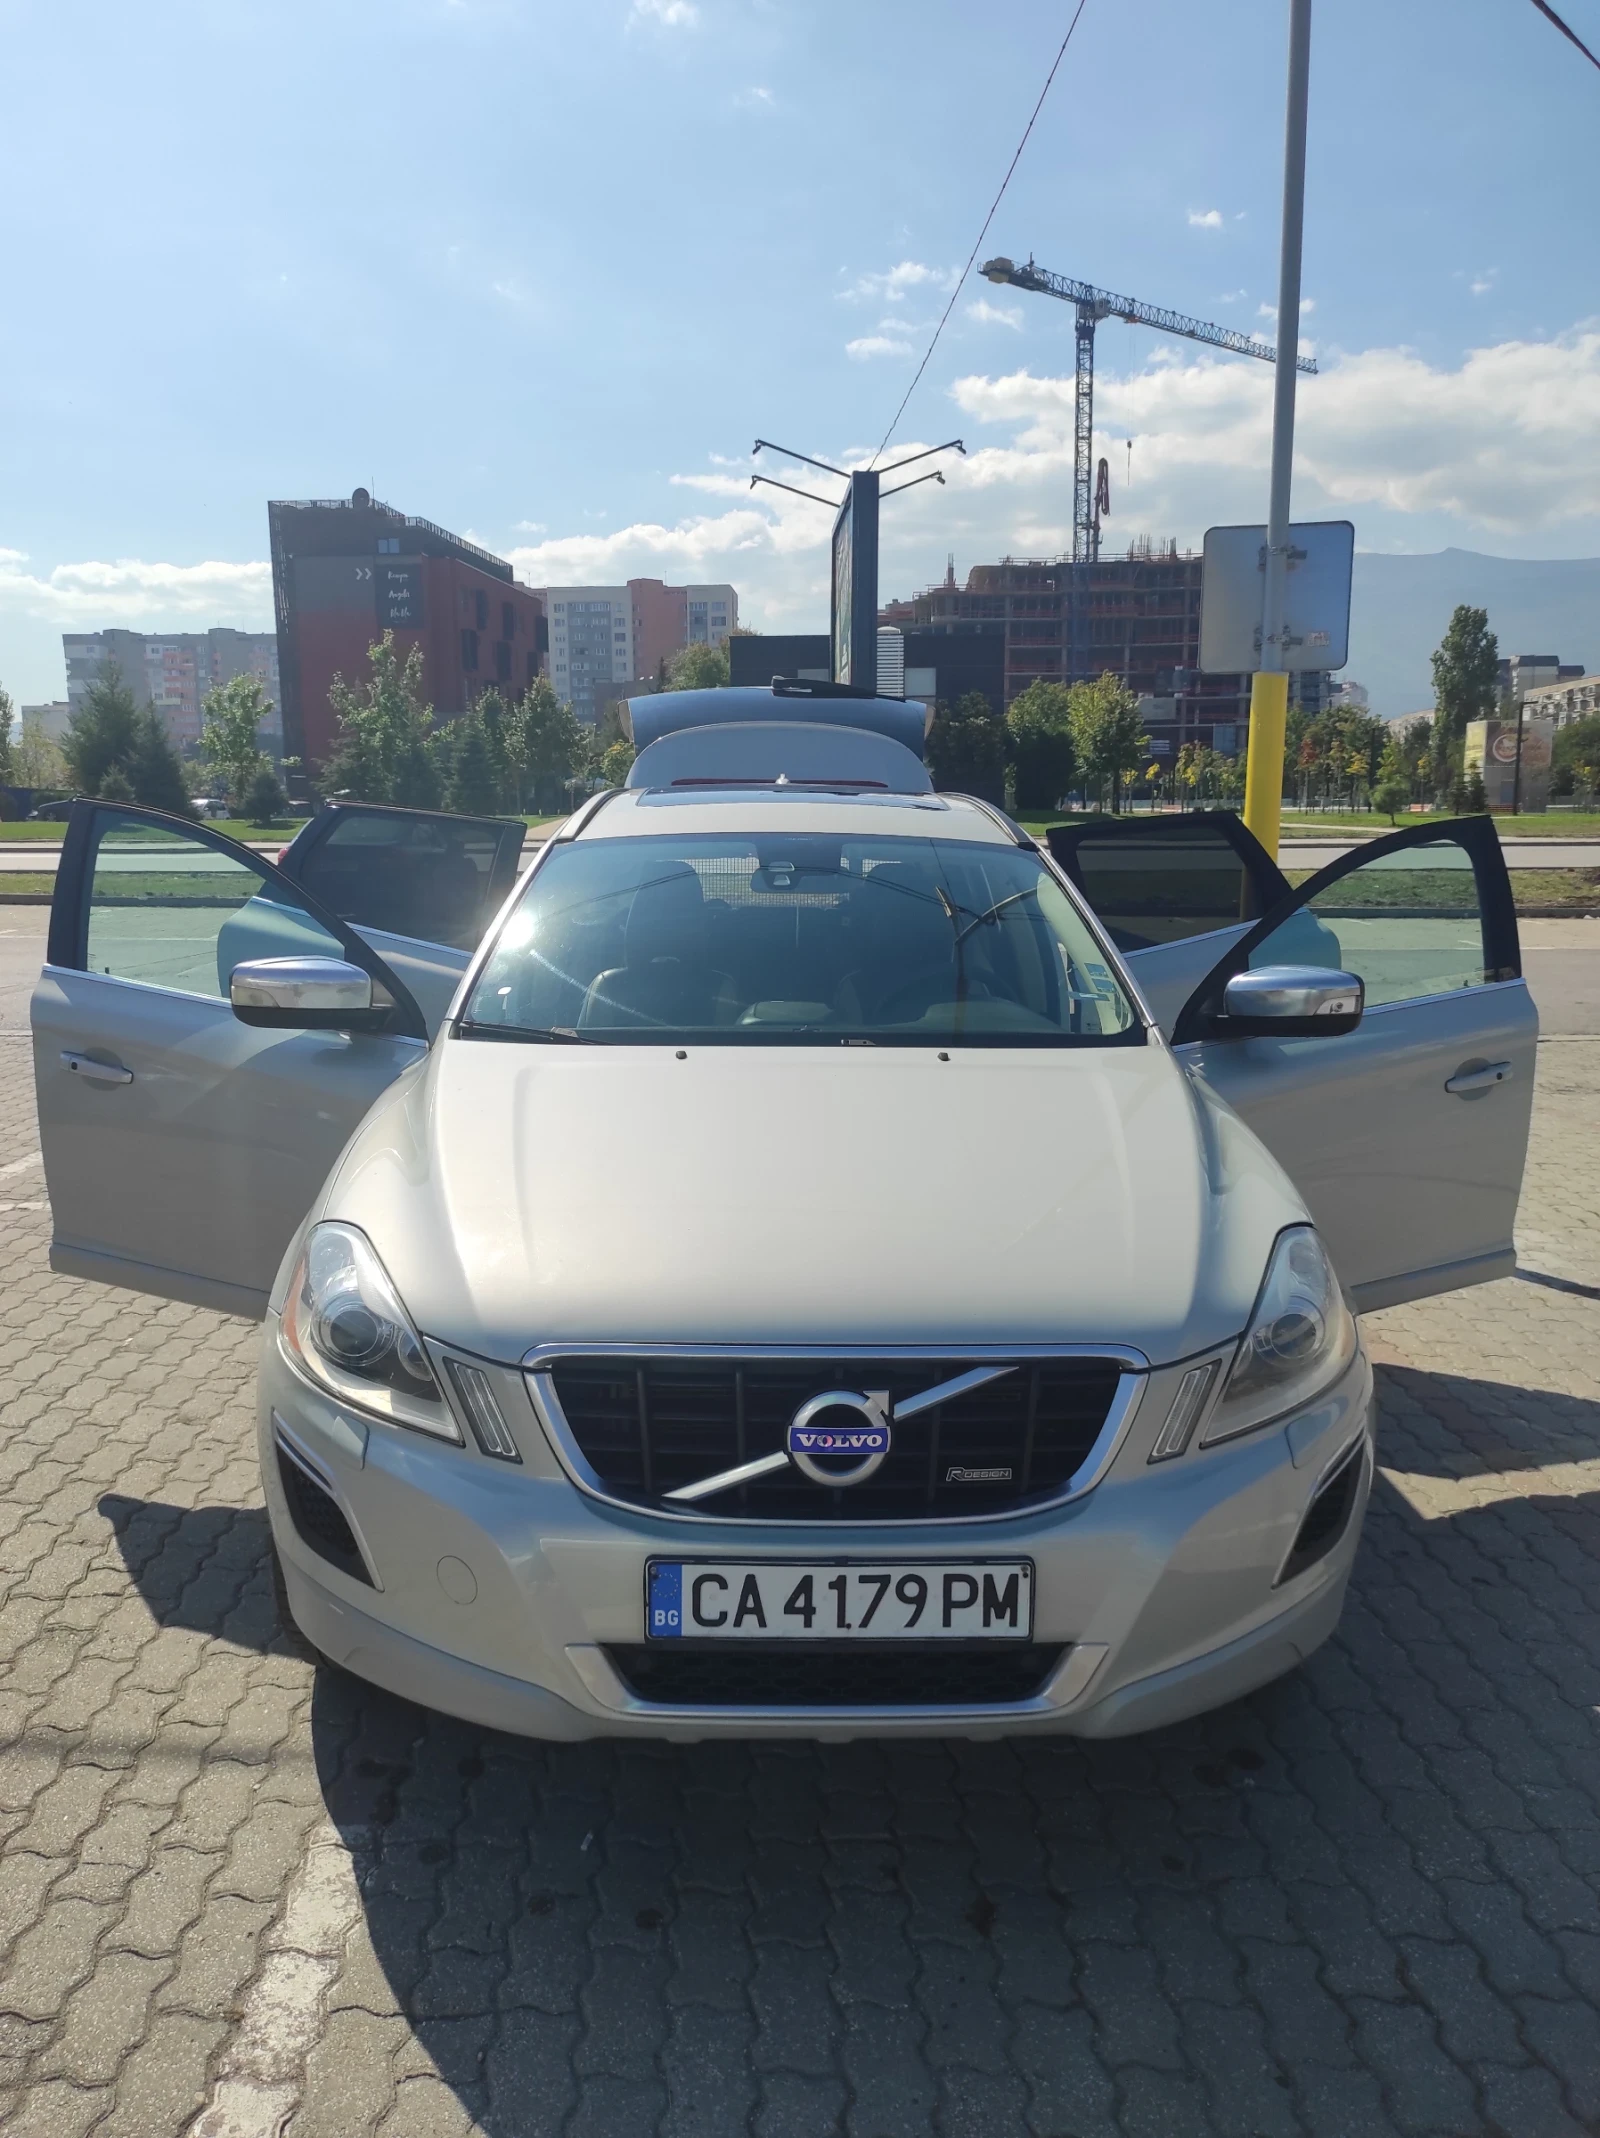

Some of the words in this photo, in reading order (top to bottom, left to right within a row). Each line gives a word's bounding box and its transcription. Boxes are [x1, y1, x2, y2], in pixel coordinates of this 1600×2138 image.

[796, 1433, 882, 1448] VOLVO
[692, 1573, 767, 1628] CA
[783, 1573, 928, 1628] 4179
[942, 1573, 1019, 1628] PM
[654, 1609, 679, 1626] BG
